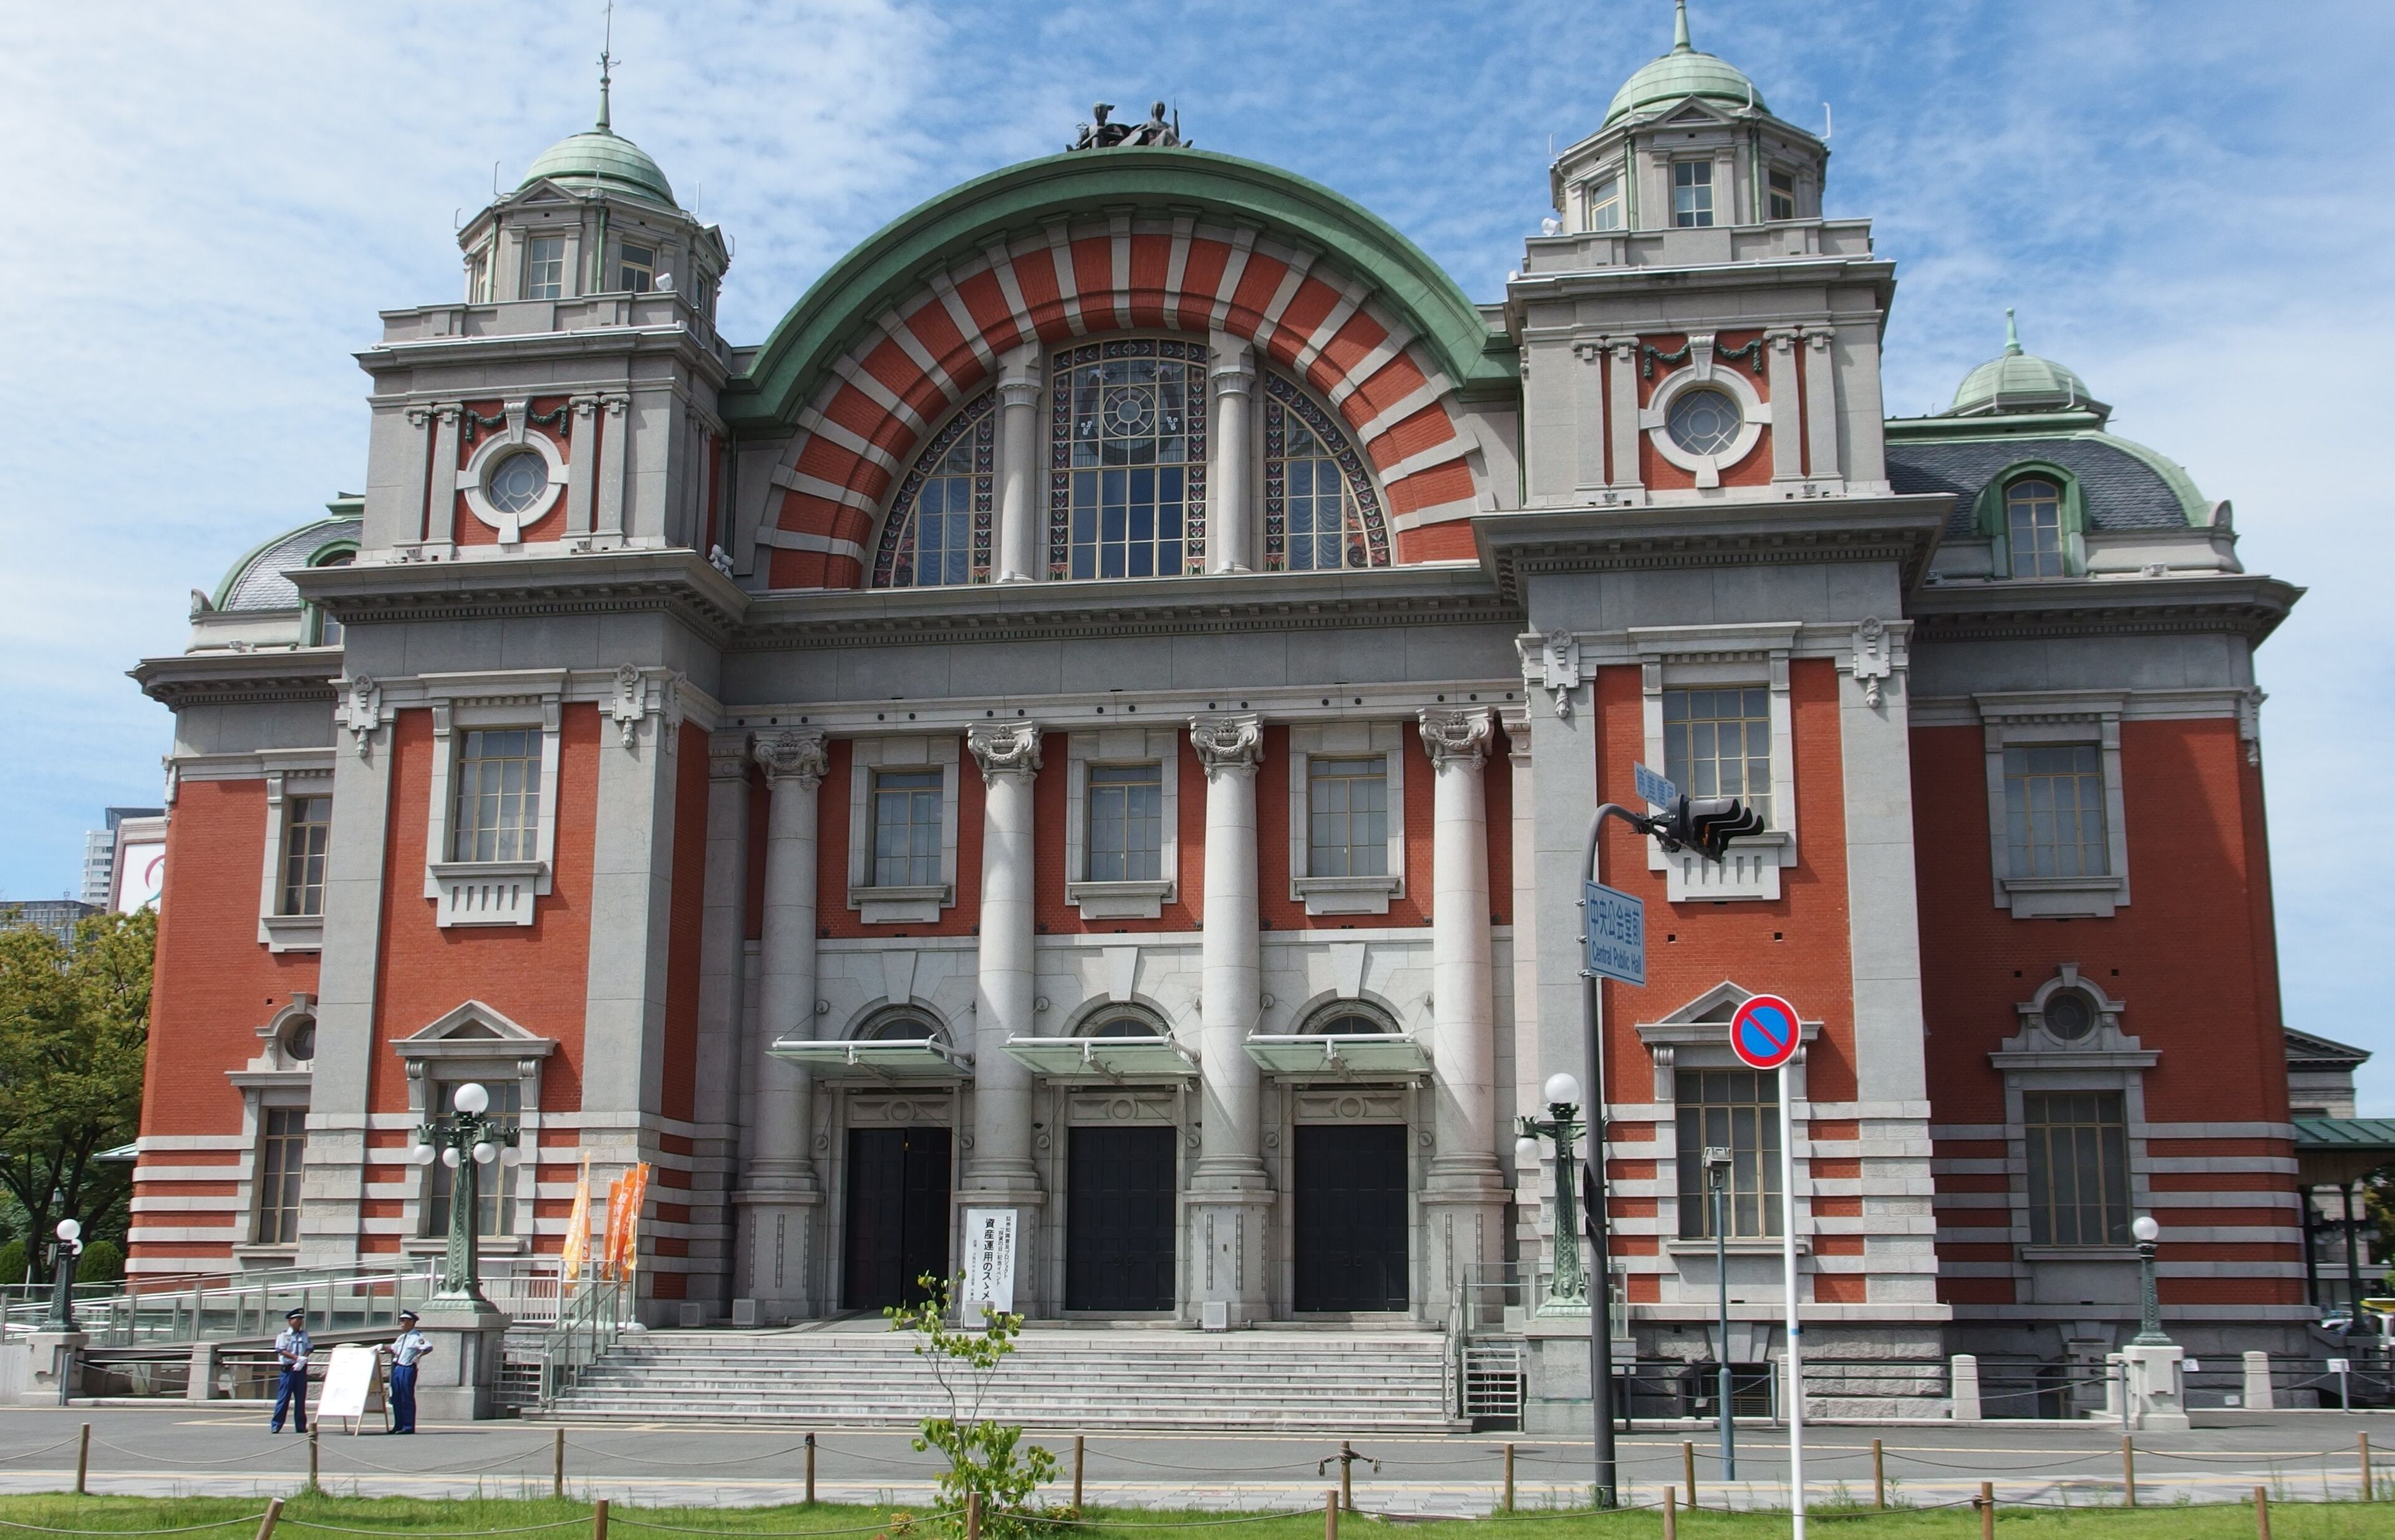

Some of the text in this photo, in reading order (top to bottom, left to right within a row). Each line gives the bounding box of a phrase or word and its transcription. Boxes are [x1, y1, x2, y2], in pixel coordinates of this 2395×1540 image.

[1590, 893, 1641, 947] 中央公会堂前
[1592, 940, 1642, 974] Central Public Hall
